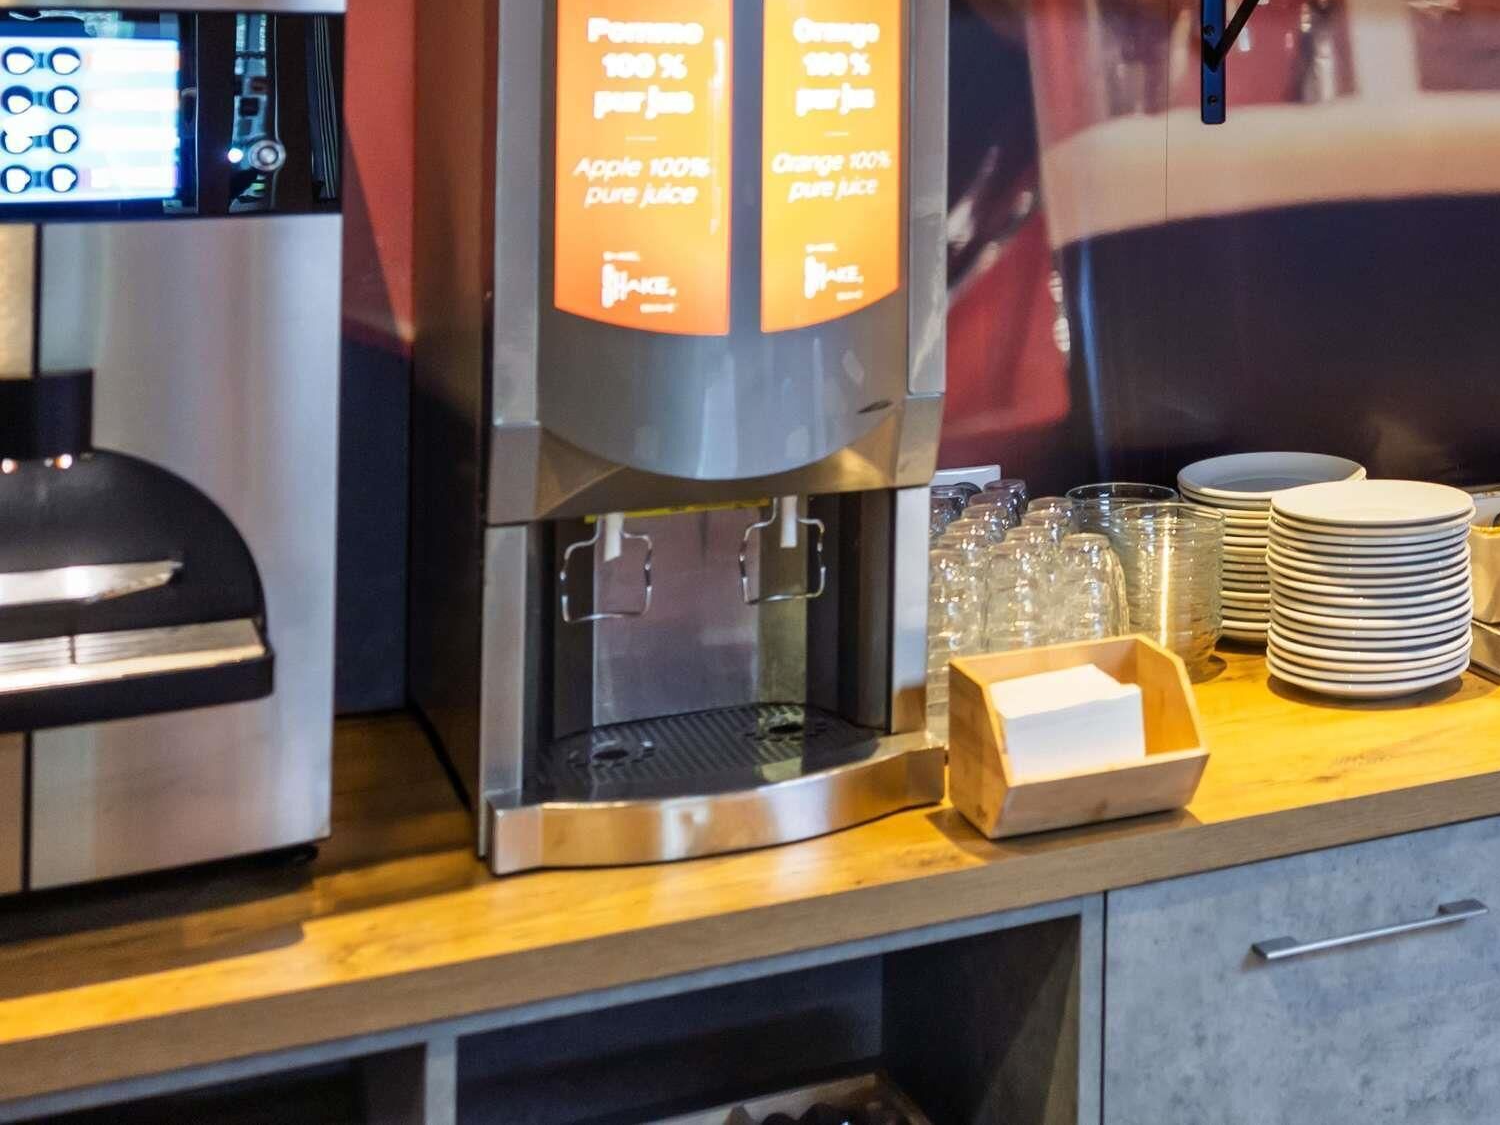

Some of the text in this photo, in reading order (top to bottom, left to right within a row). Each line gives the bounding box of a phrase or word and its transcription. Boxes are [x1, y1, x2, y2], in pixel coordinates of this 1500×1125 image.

[793, 17, 880, 49] Orange
[602, 52, 655, 79] 100
[572, 156, 711, 181] Apple 100%
[772, 150, 892, 177] Orange 100%
[584, 184, 698, 209] pure juice
[788, 177, 878, 203] pure juice
